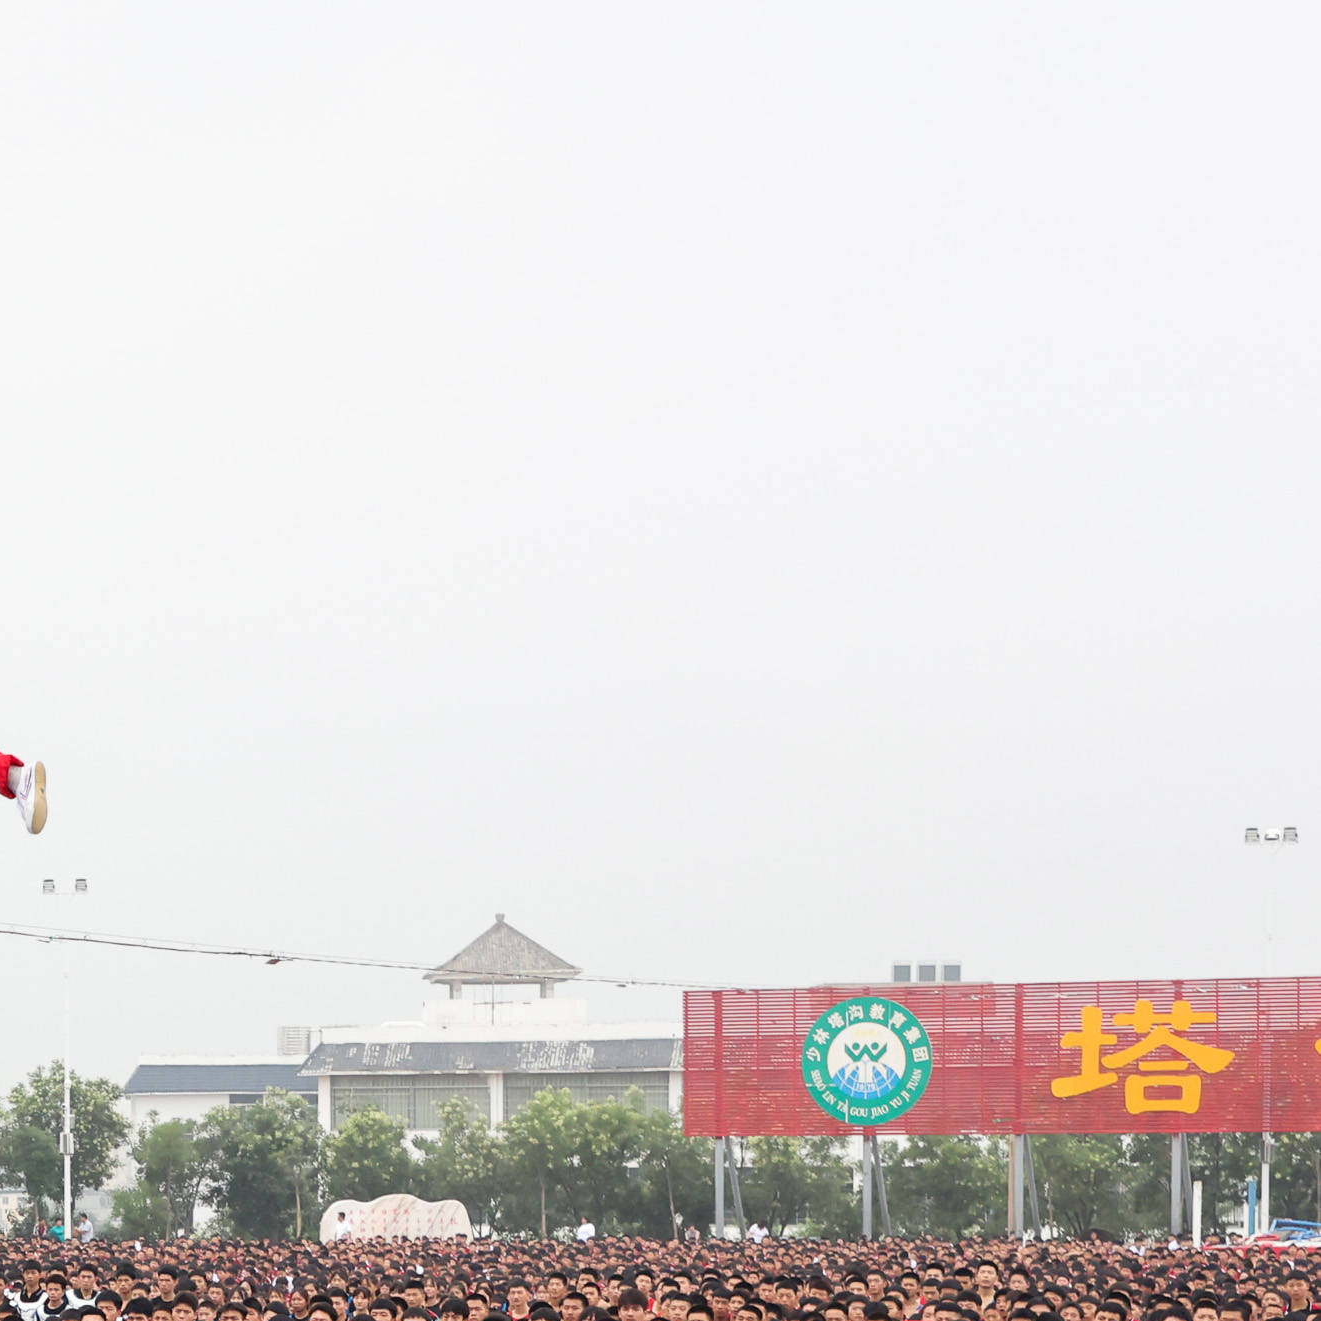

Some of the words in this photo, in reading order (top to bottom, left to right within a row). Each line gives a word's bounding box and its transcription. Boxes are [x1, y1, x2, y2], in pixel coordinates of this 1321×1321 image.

[806, 1003, 930, 1063] 少林塔沟教育集团
[1051, 1000, 1236, 1115] 塔
[822, 1091, 837, 1105] LIN
[850, 1106, 869, 1117] GOU
[870, 1104, 890, 1120] JIAO
[890, 1097, 903, 1109] YU
[900, 1090, 911, 1102] JI
[907, 1068, 923, 1091] TUAN
